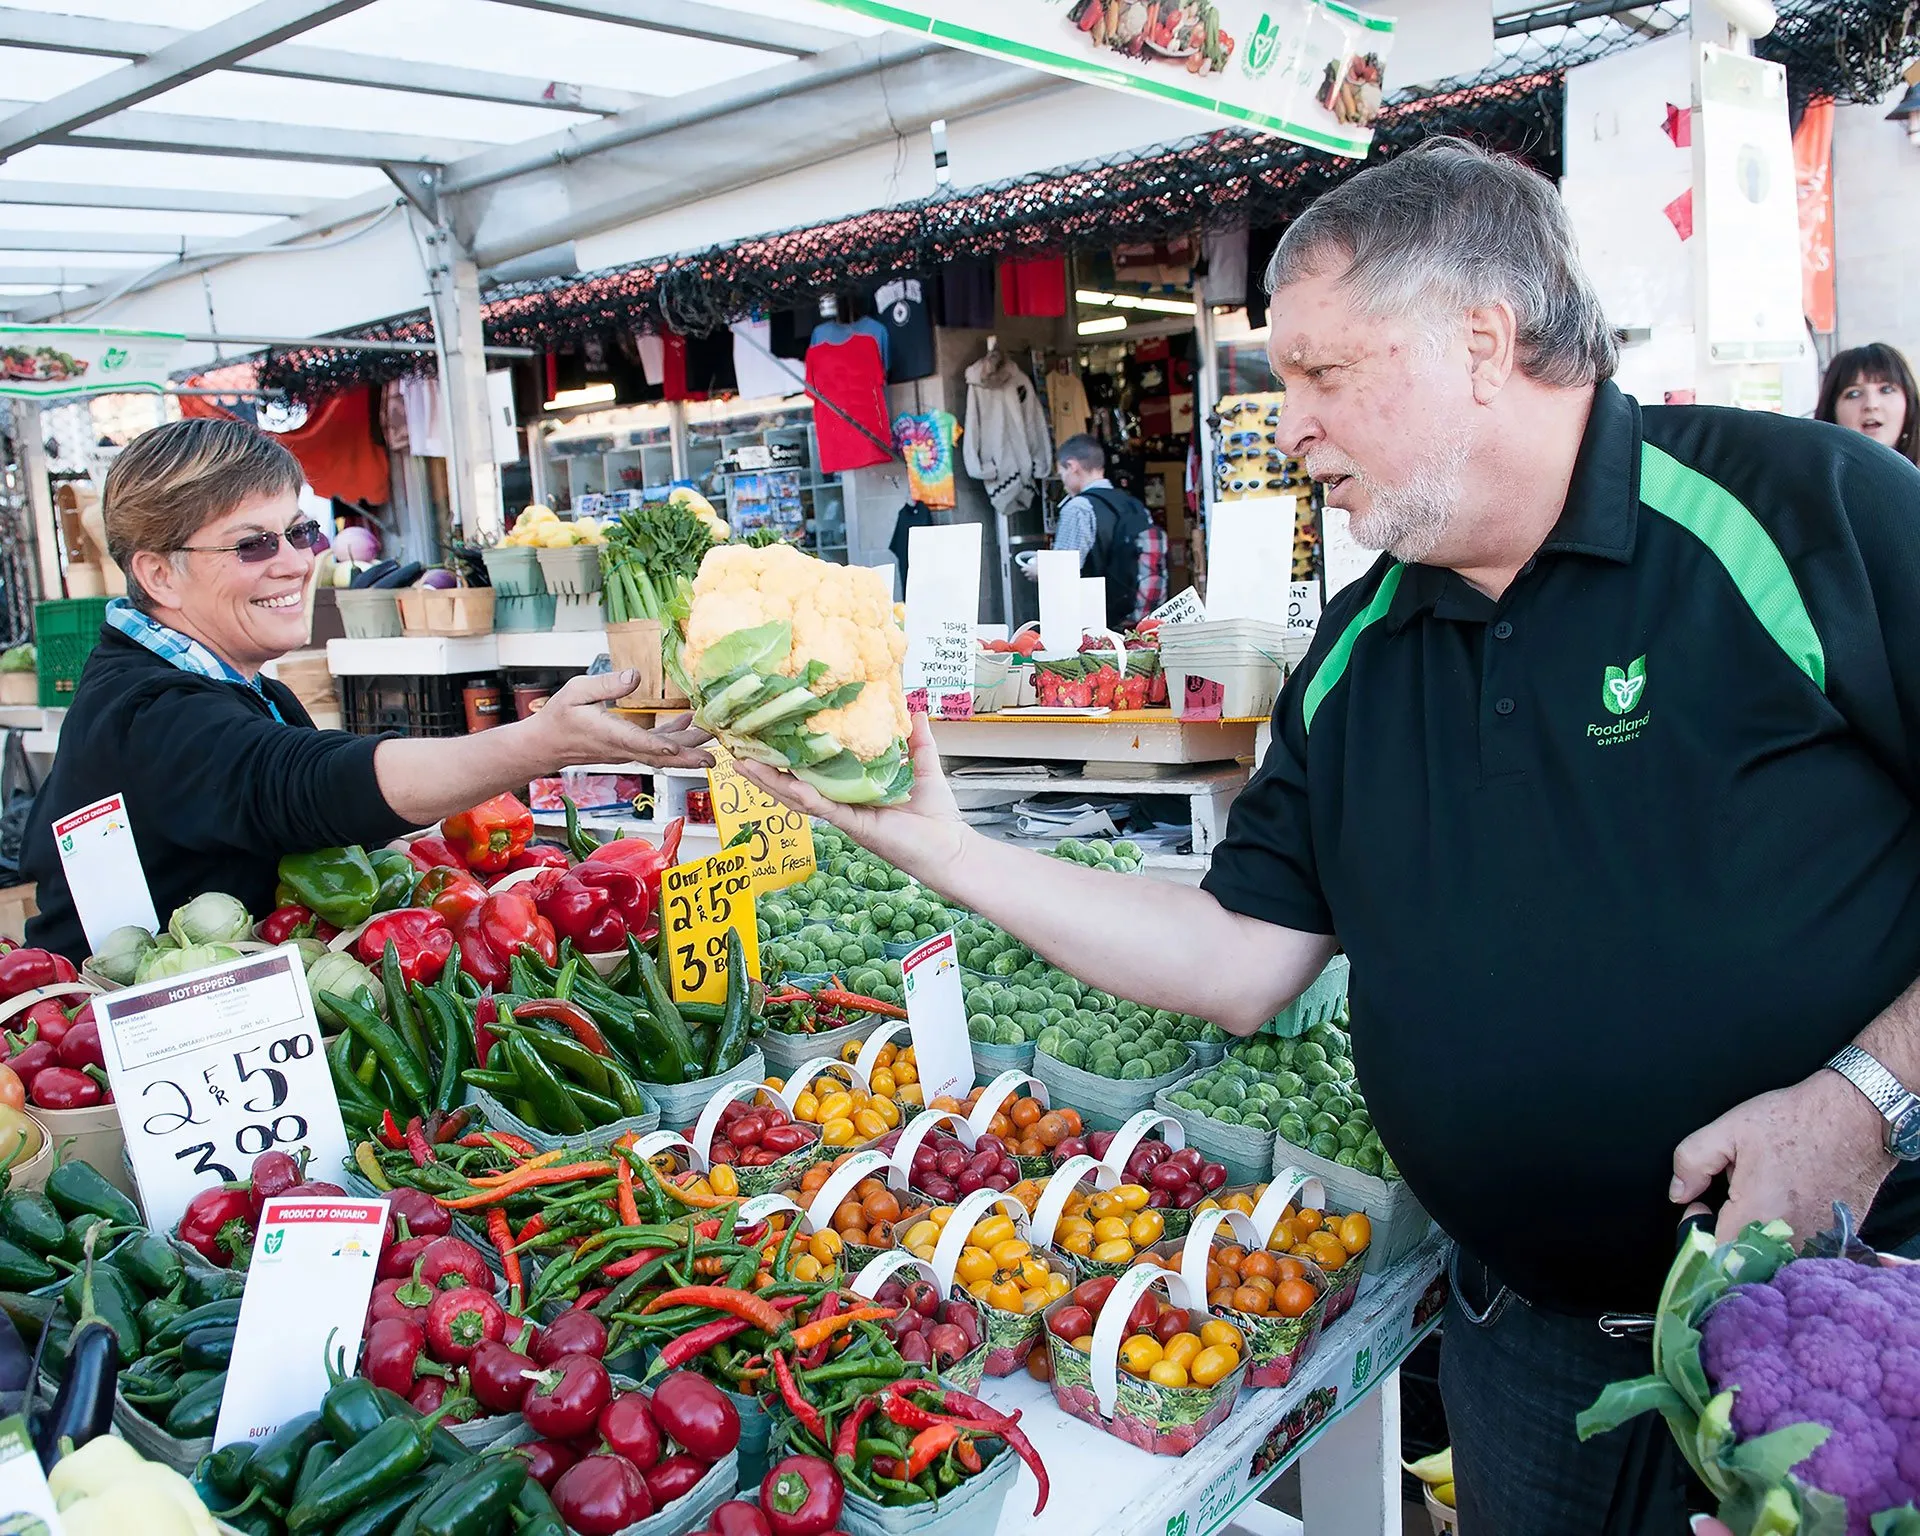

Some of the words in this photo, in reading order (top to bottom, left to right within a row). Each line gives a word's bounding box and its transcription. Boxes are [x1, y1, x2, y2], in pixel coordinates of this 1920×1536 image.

[1154, 591, 1194, 620] DWARDS
[1587, 710, 1650, 737] Foodland
[720, 782, 748, 814] 2
[670, 896, 693, 932] 2
[168, 986, 191, 1002] HOT
[192, 974, 236, 995] PEPPERS
[142, 1080, 211, 1135] 2
[279, 1209, 315, 1220] PRODUCT
[316, 1209, 328, 1218] OF
[329, 1209, 368, 1220] ONTARIO
[249, 1425, 270, 1438] BUY
[1200, 1457, 1243, 1502] ONTARIO
